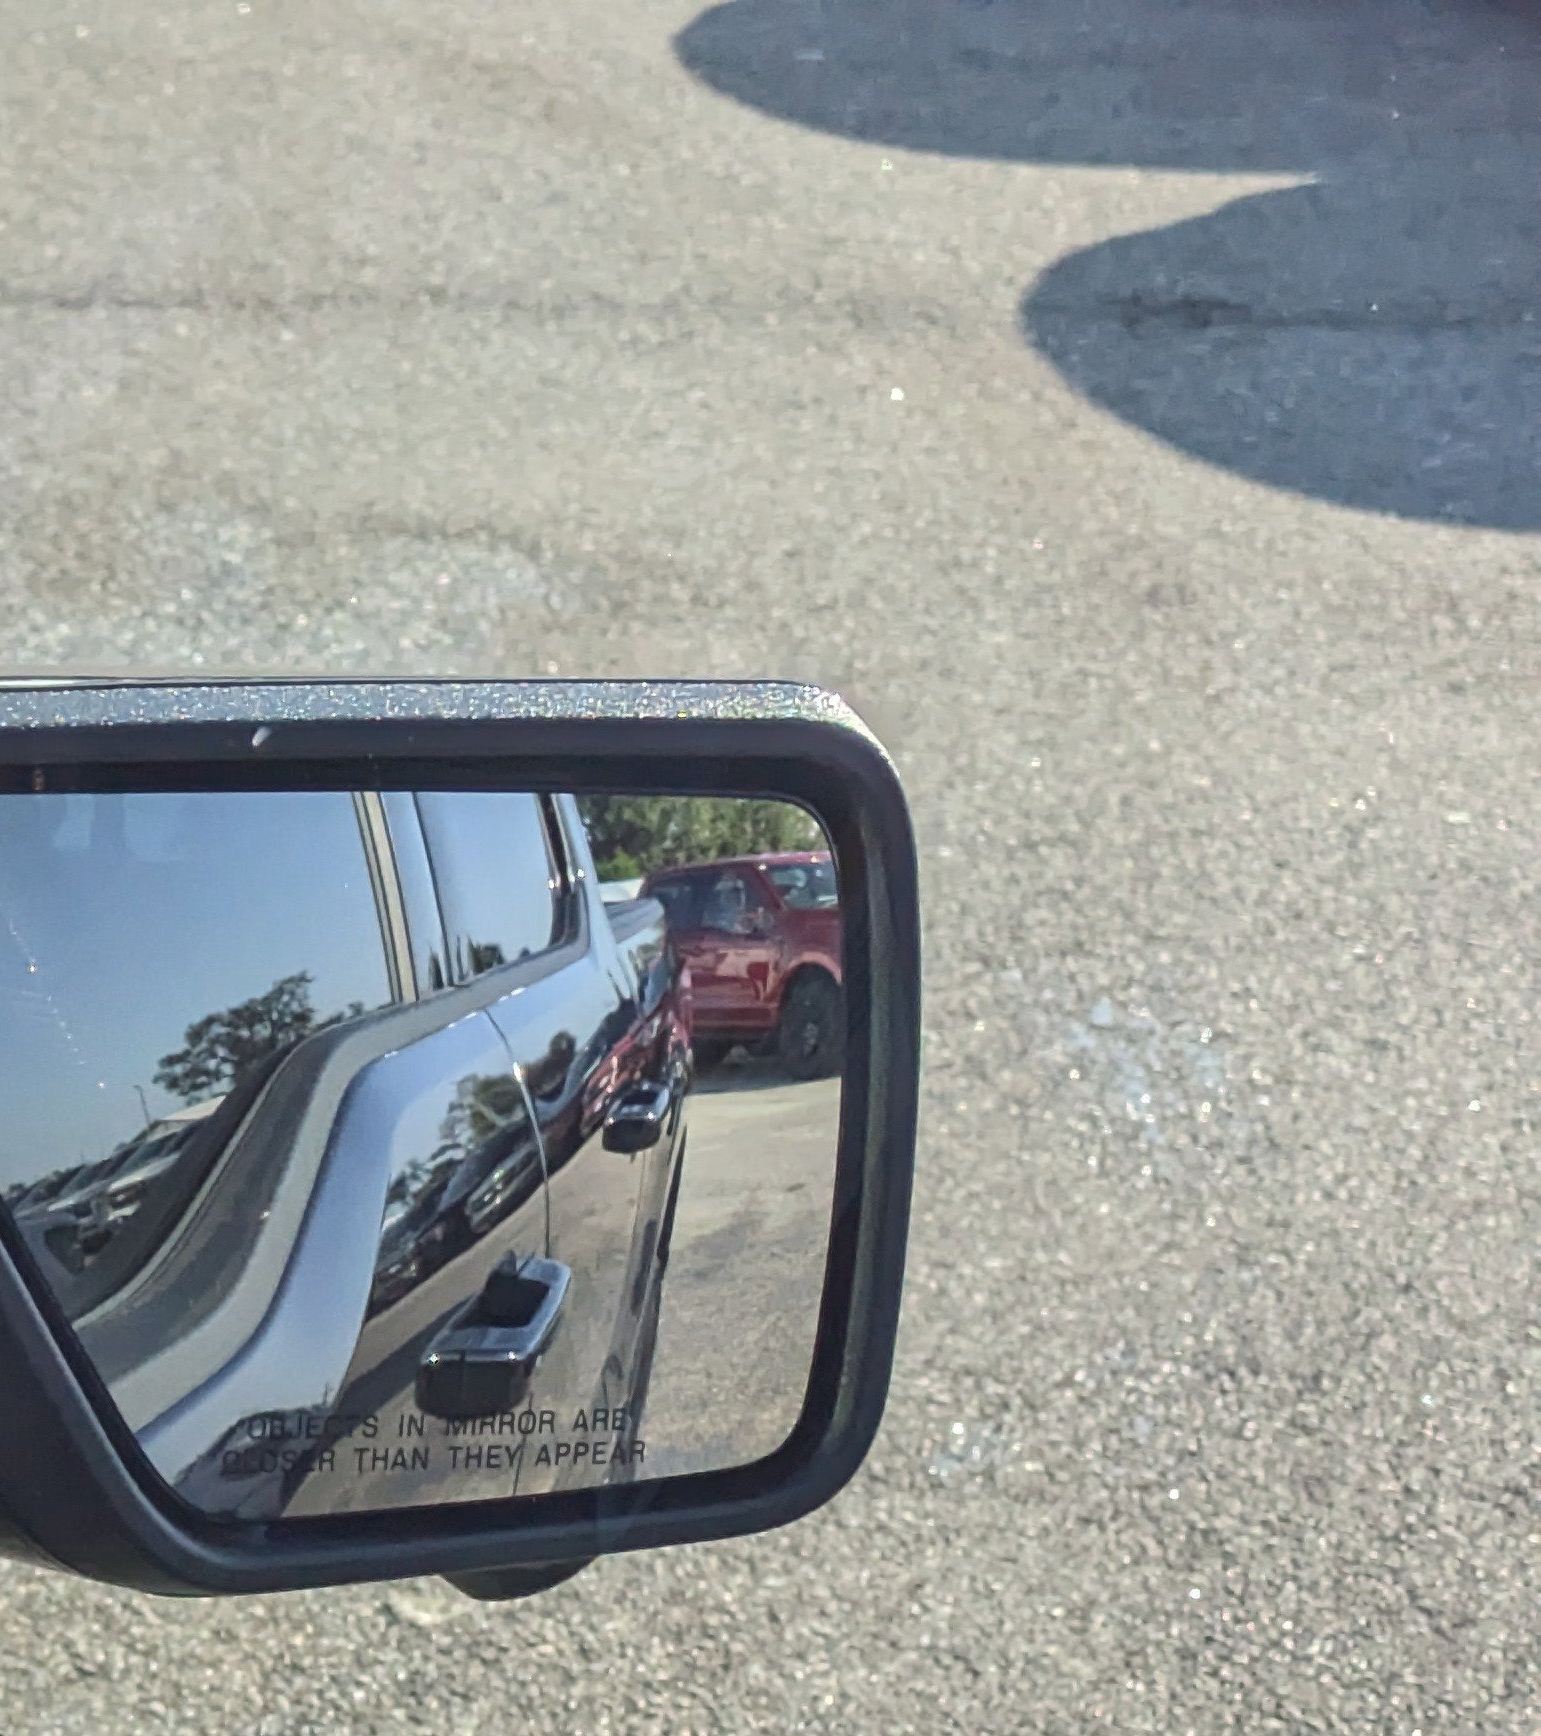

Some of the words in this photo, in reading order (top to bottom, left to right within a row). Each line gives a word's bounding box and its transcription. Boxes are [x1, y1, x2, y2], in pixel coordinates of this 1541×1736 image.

[398, 1413, 425, 1437] IN
[445, 1410, 556, 1436] MIRROR
[573, 1408, 626, 1432] ARE
[353, 1446, 430, 1473] THAN
[448, 1445, 522, 1469] THEY
[535, 1440, 646, 1466] APPEAR
